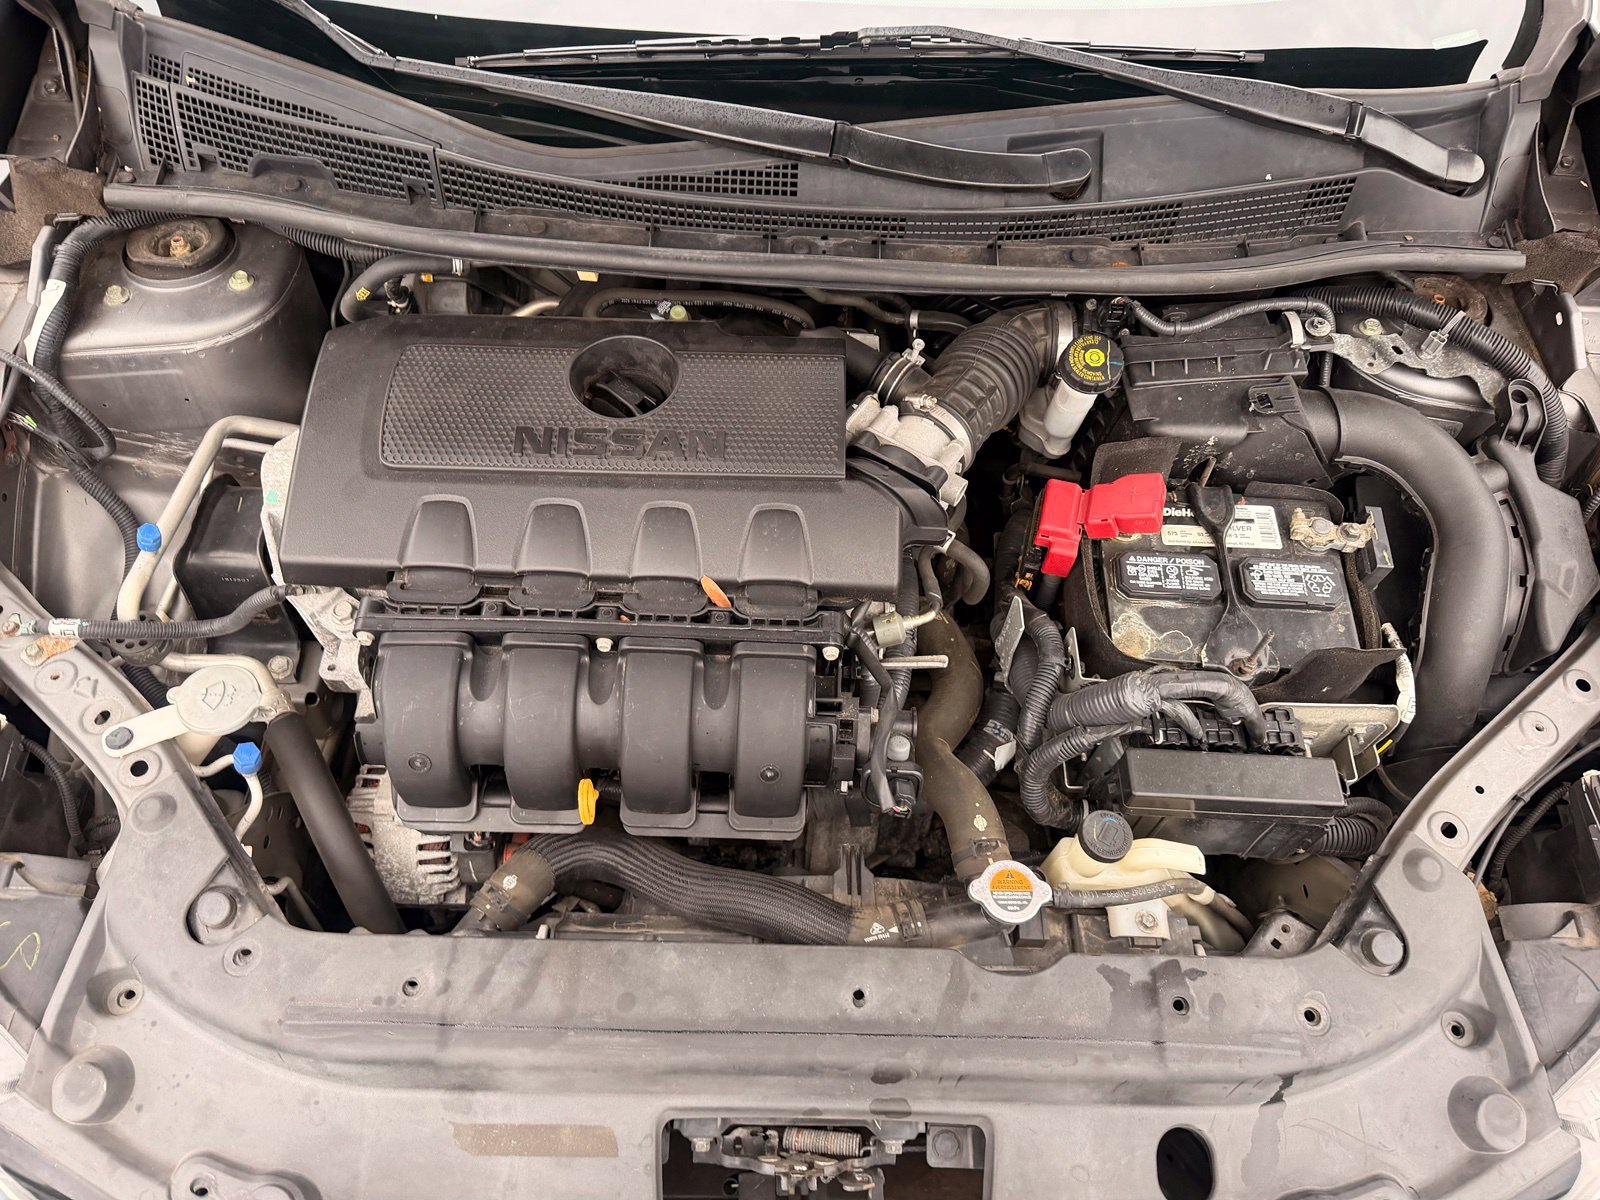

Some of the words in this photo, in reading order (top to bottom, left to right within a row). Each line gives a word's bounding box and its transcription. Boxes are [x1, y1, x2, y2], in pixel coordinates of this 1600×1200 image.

[514, 426, 727, 460] NISSAN
[1137, 555, 1168, 564] DANGER
[1176, 558, 1205, 566] POISON
